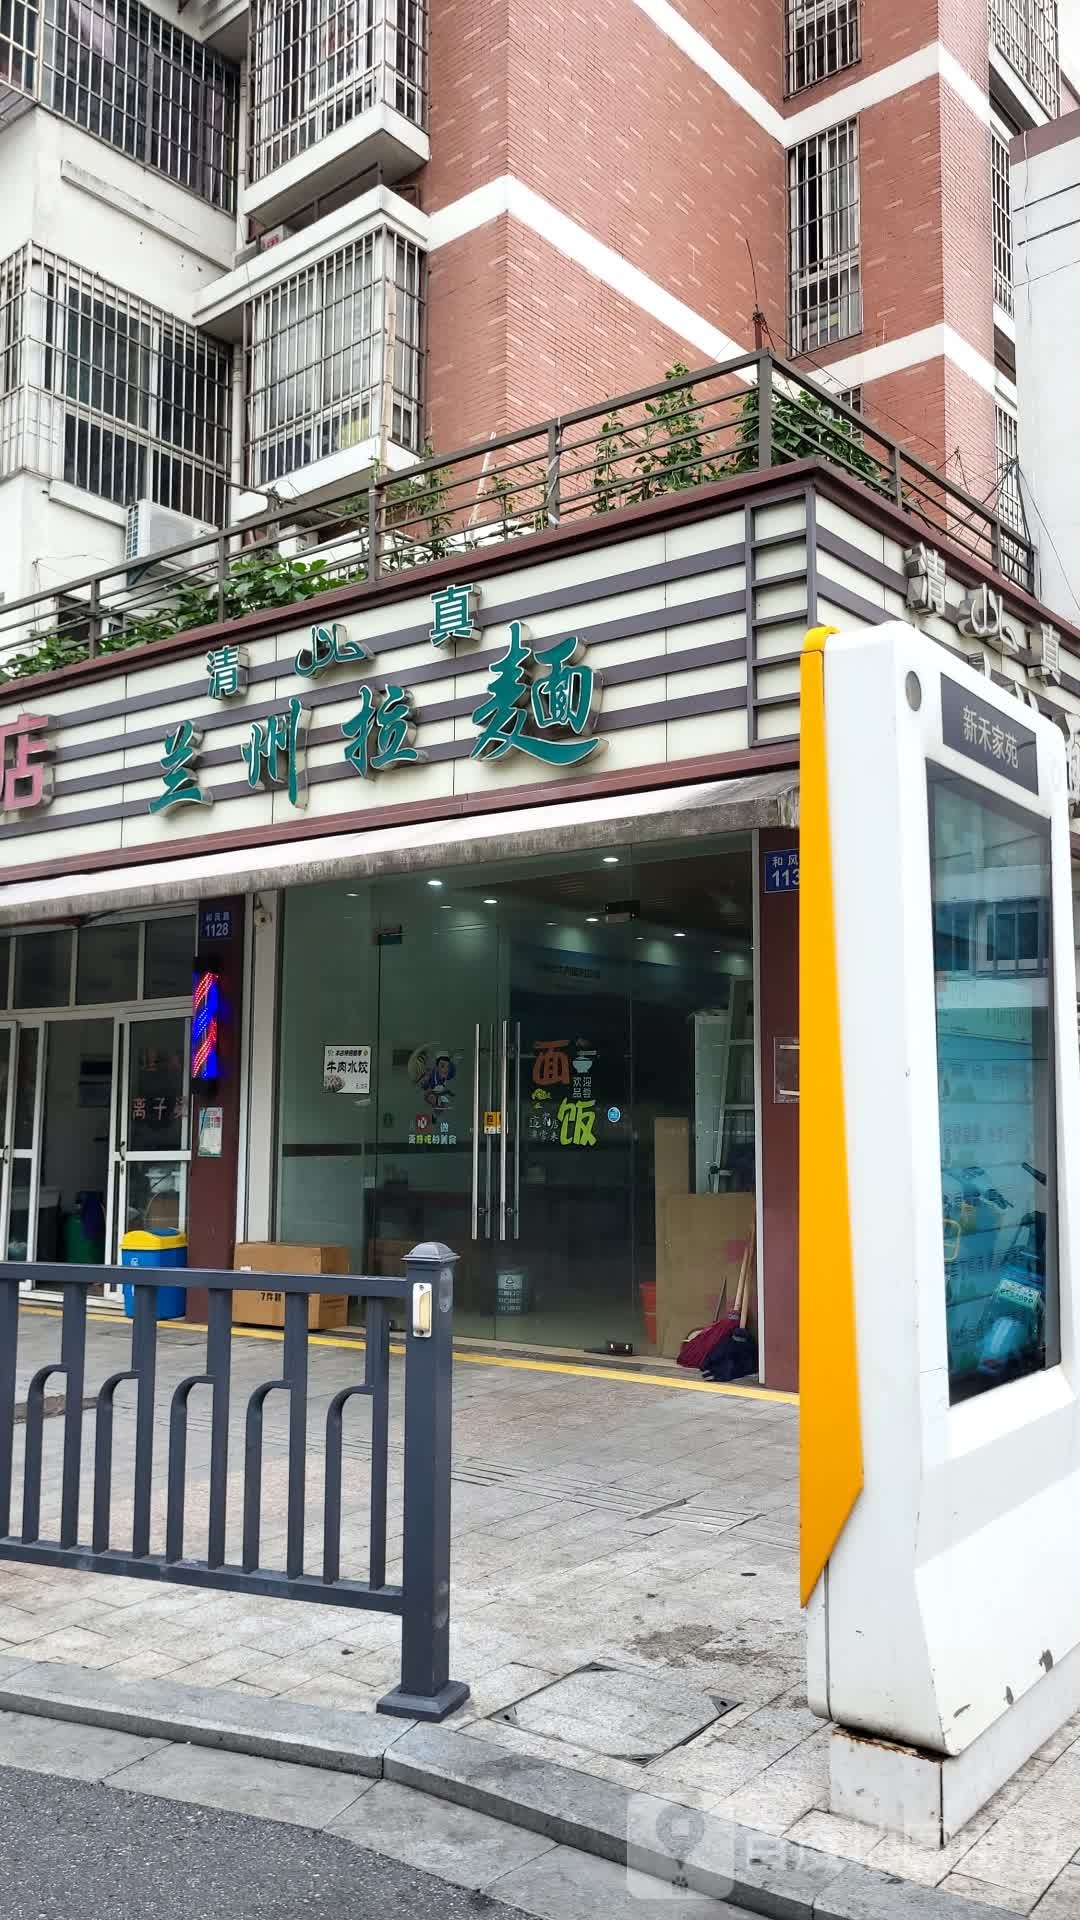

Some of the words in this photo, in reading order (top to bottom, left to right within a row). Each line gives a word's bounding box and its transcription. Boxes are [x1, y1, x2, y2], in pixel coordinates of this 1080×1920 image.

[962, 704, 1019, 769] 新禾家苑
[0, 713, 49, 811] 店
[205, 922, 229, 936] 1128
[326, 1060, 369, 1074] 牛肉水饺
[532, 1040, 571, 1086] 面
[557, 1097, 597, 1146] 饭
